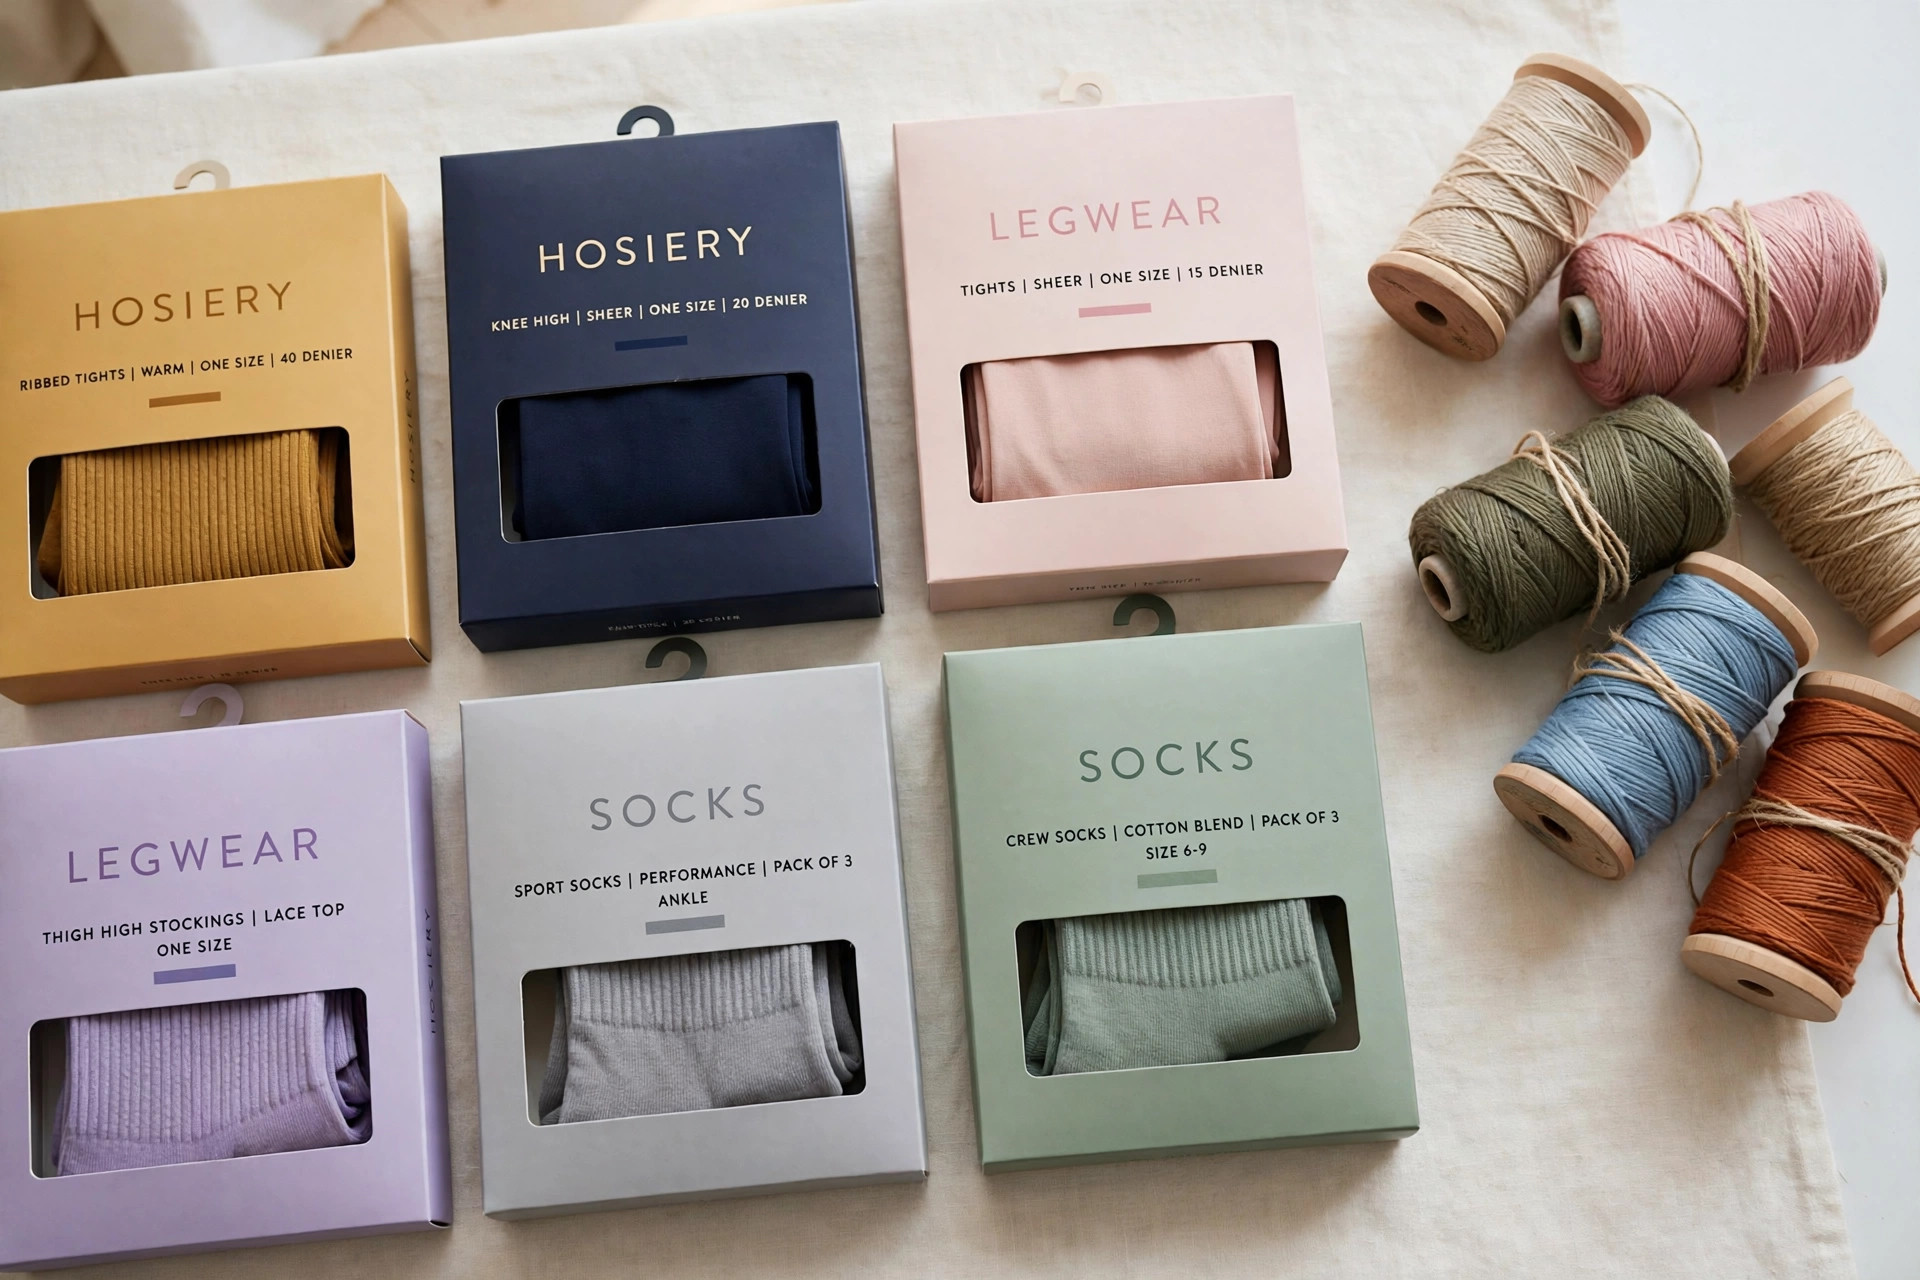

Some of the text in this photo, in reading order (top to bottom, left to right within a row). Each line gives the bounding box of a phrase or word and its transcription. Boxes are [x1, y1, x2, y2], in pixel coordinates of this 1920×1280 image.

[990, 197, 1220, 240] LEGWEAR
[540, 226, 751, 272] HOSIERY
[960, 281, 1015, 296] TIGHTS
[1034, 275, 1082, 290] SHEER
[1100, 271, 1132, 284] ONE
[1138, 269, 1170, 281] SIZE
[1188, 267, 1202, 278] 15
[1209, 264, 1263, 277] DENIER
[76, 282, 290, 331] HOSIERY
[492, 317, 528, 331] KNEE
[534, 313, 569, 327] HIGH
[587, 307, 632, 321] SHEER
[650, 302, 680, 315] ONE
[686, 300, 716, 312] SIZE
[733, 298, 749, 308] 20
[755, 294, 807, 307] DENIER
[20, 375, 70, 391] RIBBED
[75, 369, 125, 384] TIGHTS
[141, 363, 184, 377] WARM
[200, 359, 229, 371] ONE
[235, 355, 264, 368] SIZE
[280, 352, 296, 363] 40
[303, 348, 352, 362] DENIER
[1080, 739, 1252, 782] SOCKS
[590, 784, 764, 830] SOCKS
[1006, 832, 1049, 847] CREW
[1055, 827, 1106, 843] SOCKS
[1124, 821, 1188, 837] COTTON
[1194, 817, 1243, 832] BLEND
[1262, 813, 1301, 827] PACK
[1306, 811, 1325, 824] OF
[1331, 811, 1339, 823] 3
[69, 828, 317, 883] LEGWEAR
[1146, 843, 1206, 860] SIZE 6-9
[515, 881, 564, 898] SPORT
[570, 875, 621, 892] SOCKS
[640, 863, 755, 885] PERFORMANCE
[774, 858, 814, 872] PACK
[819, 856, 838, 868] OF
[845, 855, 852, 867] 3
[658, 891, 708, 907] ANKLE
[42, 927, 93, 944] THIGH
[101, 922, 142, 938] HIGH
[150, 913, 244, 933] STOCKINGS
[265, 906, 306, 922] LACE
[312, 903, 344, 917] TOP
[157, 938, 232, 957] ONE SIZE
